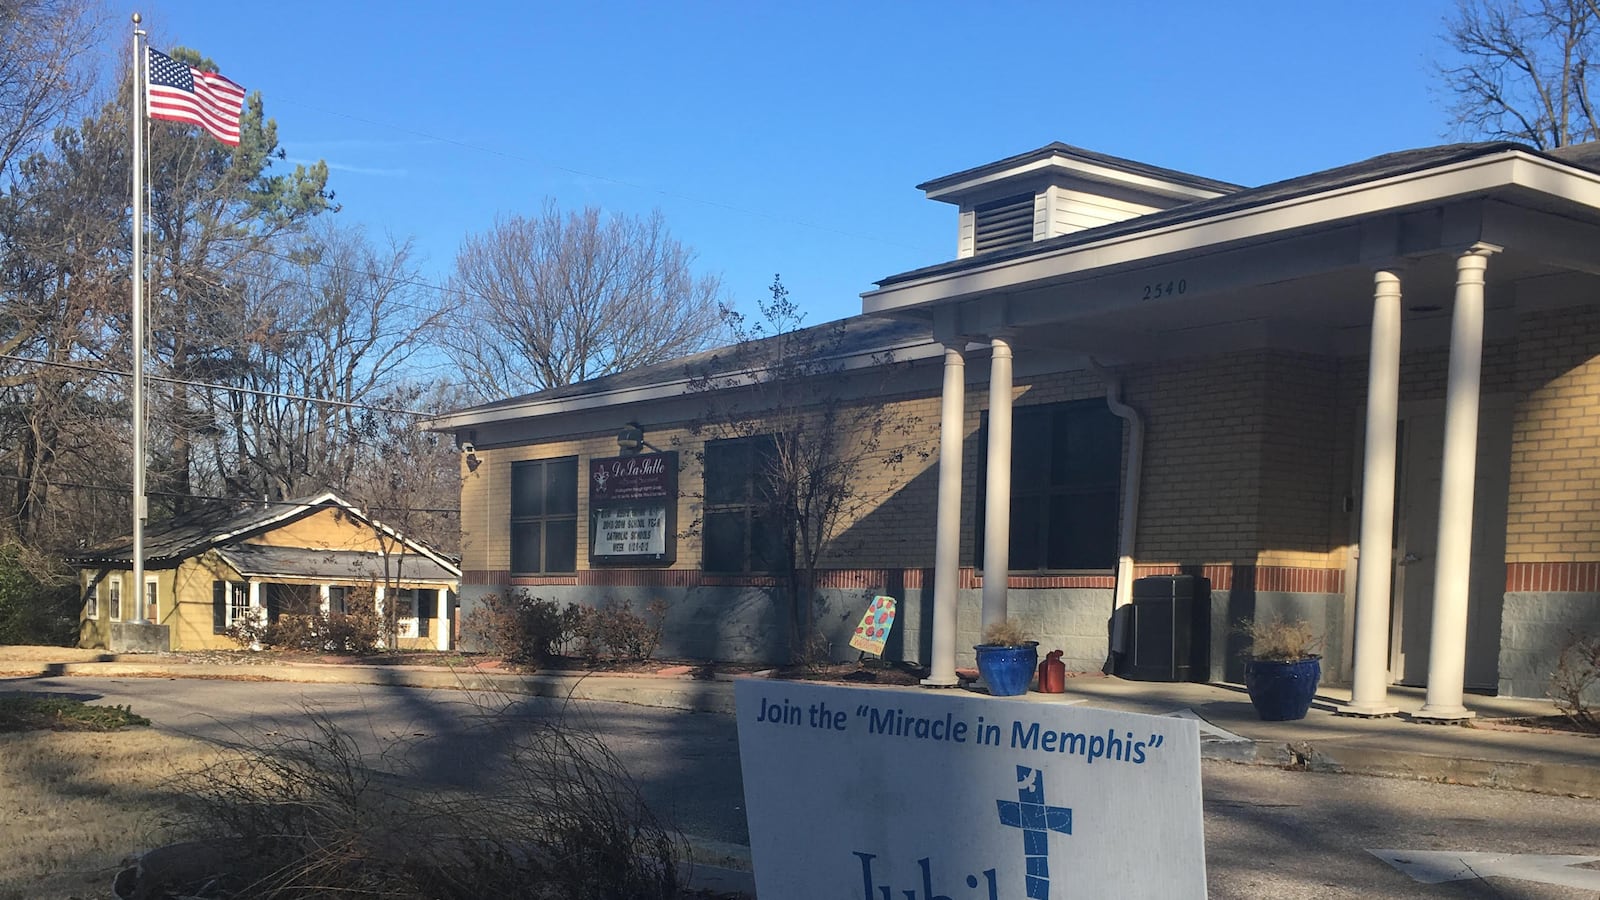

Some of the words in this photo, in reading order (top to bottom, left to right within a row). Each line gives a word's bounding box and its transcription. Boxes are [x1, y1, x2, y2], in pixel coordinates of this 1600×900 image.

[1142, 279, 1186, 301] 2540
[628, 518, 645, 529] SCHOOL
[606, 531, 628, 541] CATHOLIC
[630, 530, 652, 540] SCHOOLS
[756, 697, 801, 726] Join
[808, 702, 847, 731] the
[856, 704, 968, 743] “Miracle
[976, 716, 1001, 746] in
[1011, 721, 1164, 764] Memphis”
